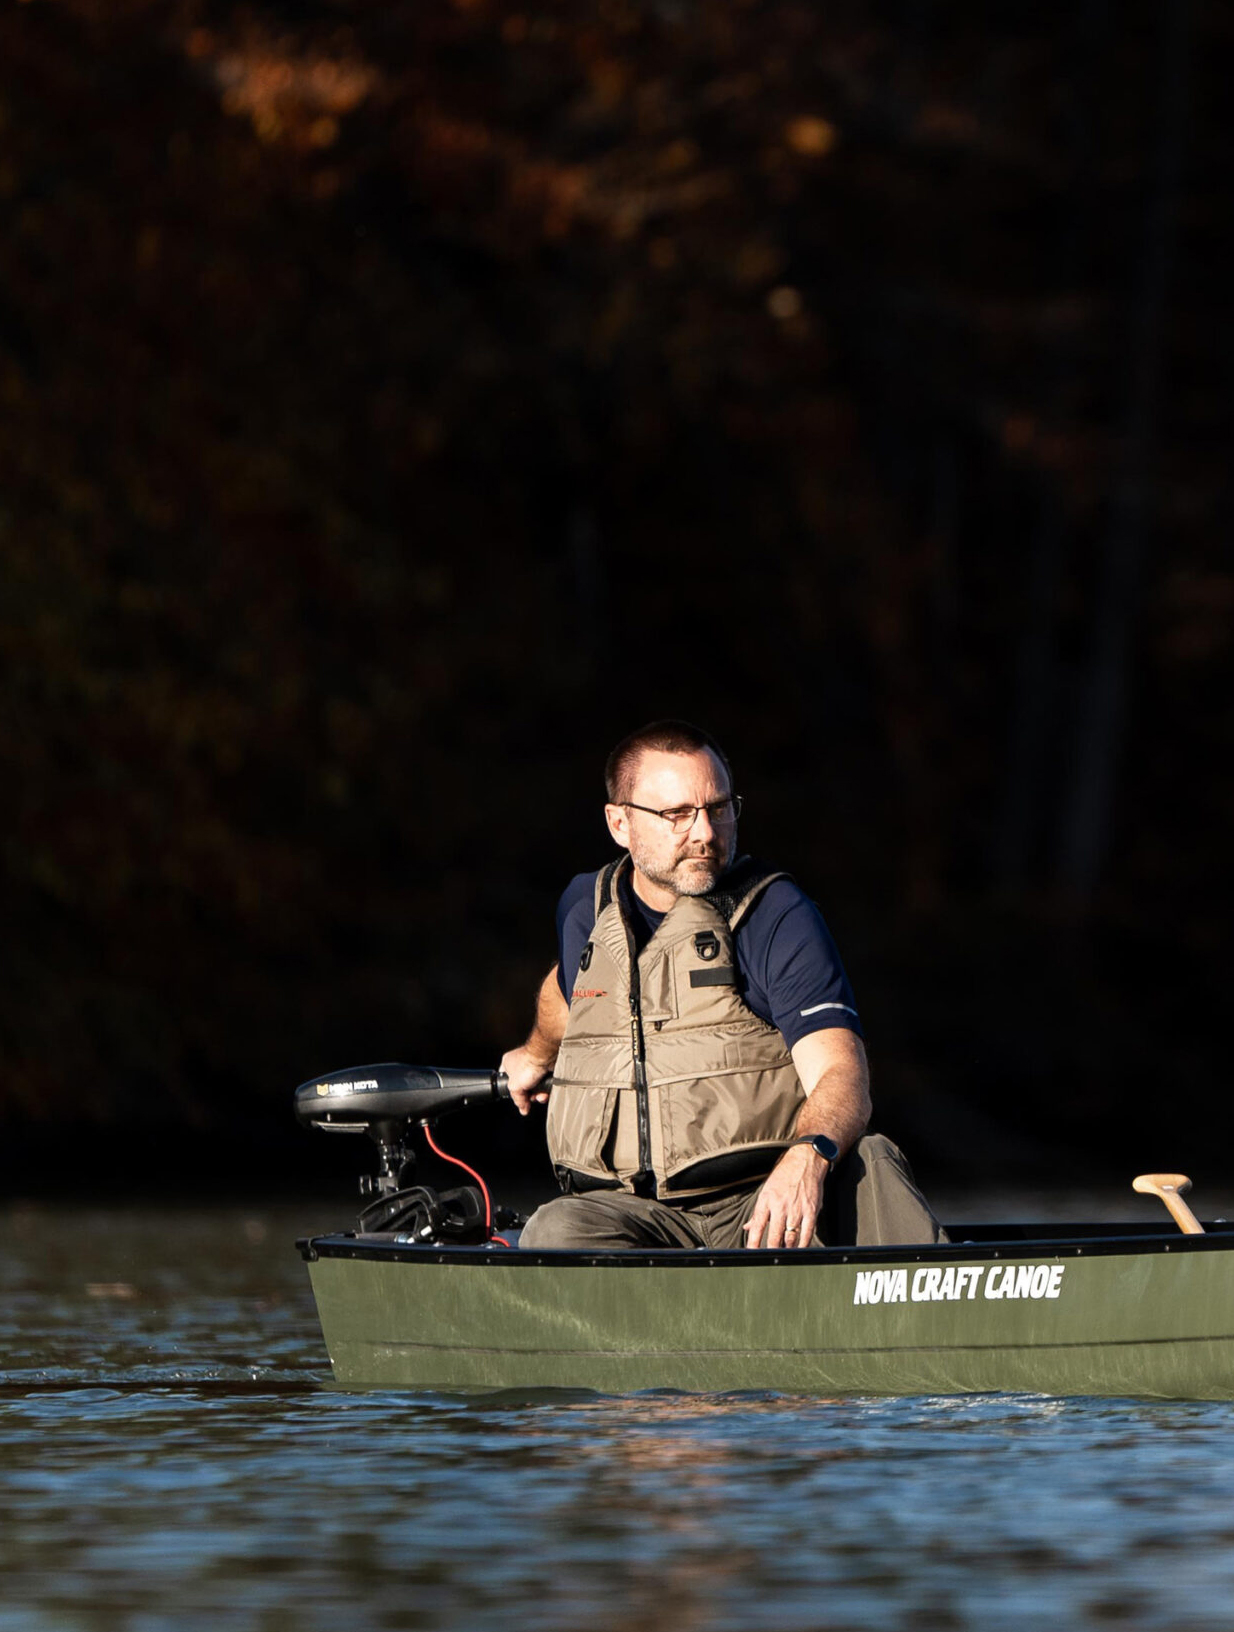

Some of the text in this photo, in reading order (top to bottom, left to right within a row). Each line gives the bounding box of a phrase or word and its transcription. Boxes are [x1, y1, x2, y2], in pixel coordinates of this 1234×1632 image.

[354, 1080, 378, 1089] KOTA
[854, 1264, 1065, 1305] NOVA CRAFT CANOE
